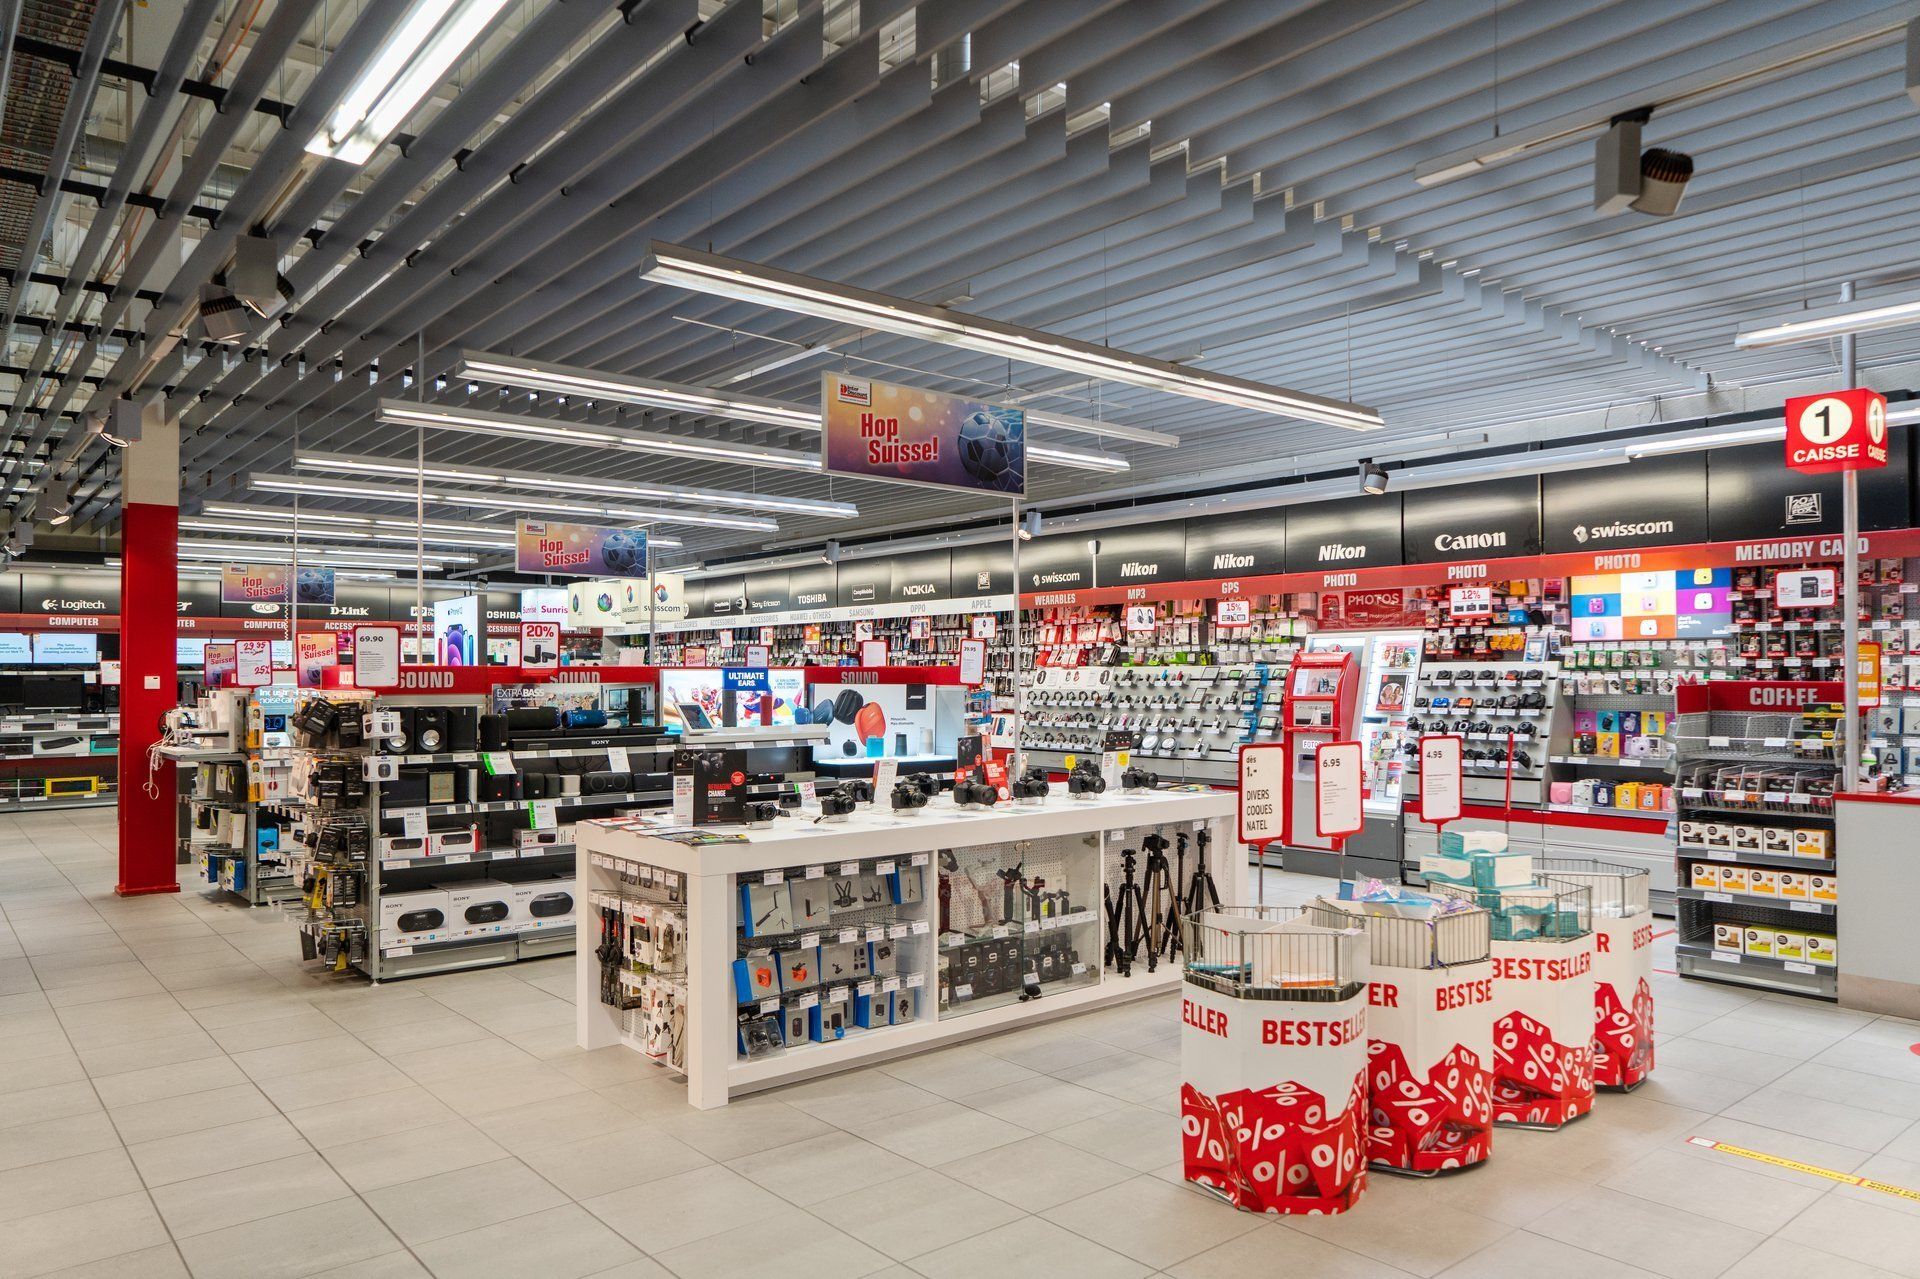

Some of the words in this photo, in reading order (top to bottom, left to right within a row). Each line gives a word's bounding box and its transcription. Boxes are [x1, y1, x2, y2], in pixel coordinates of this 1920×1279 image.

[1815, 405, 1830, 437] 1
[1873, 406, 1879, 437] 1
[861, 413, 898, 442] Hop
[868, 436, 938, 464] Suisse!
[1793, 444, 1860, 463] CAISSE
[1591, 520, 1673, 539] swisscom
[540, 539, 563, 554] Hop
[1434, 531, 1507, 551] Canon
[1318, 544, 1366, 562] Nikon
[1736, 541, 1813, 562] MEMORY
[1820, 537, 1869, 558] CAD
[544, 549, 589, 566] Suisse!
[1213, 553, 1254, 570] Nikon
[1594, 554, 1641, 570] PHOTO
[1121, 562, 1158, 577] Nikon
[1447, 564, 1487, 579] PHOTO
[242, 577, 262, 588] Hop
[1041, 572, 1080, 584] swisscom
[1323, 573, 1357, 587] PHOTO
[246, 584, 285, 598] Suisse!
[903, 584, 936, 595] NOKIA
[1127, 588, 1146, 600] MP3
[1221, 582, 1239, 594] GPS
[798, 594, 827, 605] TOSHIBA
[1035, 594, 1076, 606] WEARABLES
[1348, 593, 1399, 605] PHOTOS
[1461, 590, 1481, 599] 12%
[61, 600, 106, 610] Logitech
[541, 605, 569, 614] Sunris
[910, 604, 926, 613] OPPO
[971, 599, 992, 610] APPLE
[1226, 603, 1242, 612] 15%
[330, 606, 370, 616] D-Link
[849, 608, 875, 617] SAMSUNG
[49, 617, 99, 626] COMPUTER
[244, 620, 286, 629] COMPUTER
[526, 625, 555, 638] 20%
[301, 643, 316, 652] Hop
[304, 647, 334, 660] Suisse!
[208, 652, 221, 660] Hop
[728, 672, 765, 680] ULTIMATE
[841, 671, 879, 684] SOUND
[1246, 755, 1257, 763] dès
[1426, 750, 1443, 758] 4.95
[1322, 758, 1341, 768] 6.95
[1246, 789, 1270, 800] DIVERS
[1246, 804, 1273, 816] COQUES
[1246, 820, 1268, 831] NATEL
